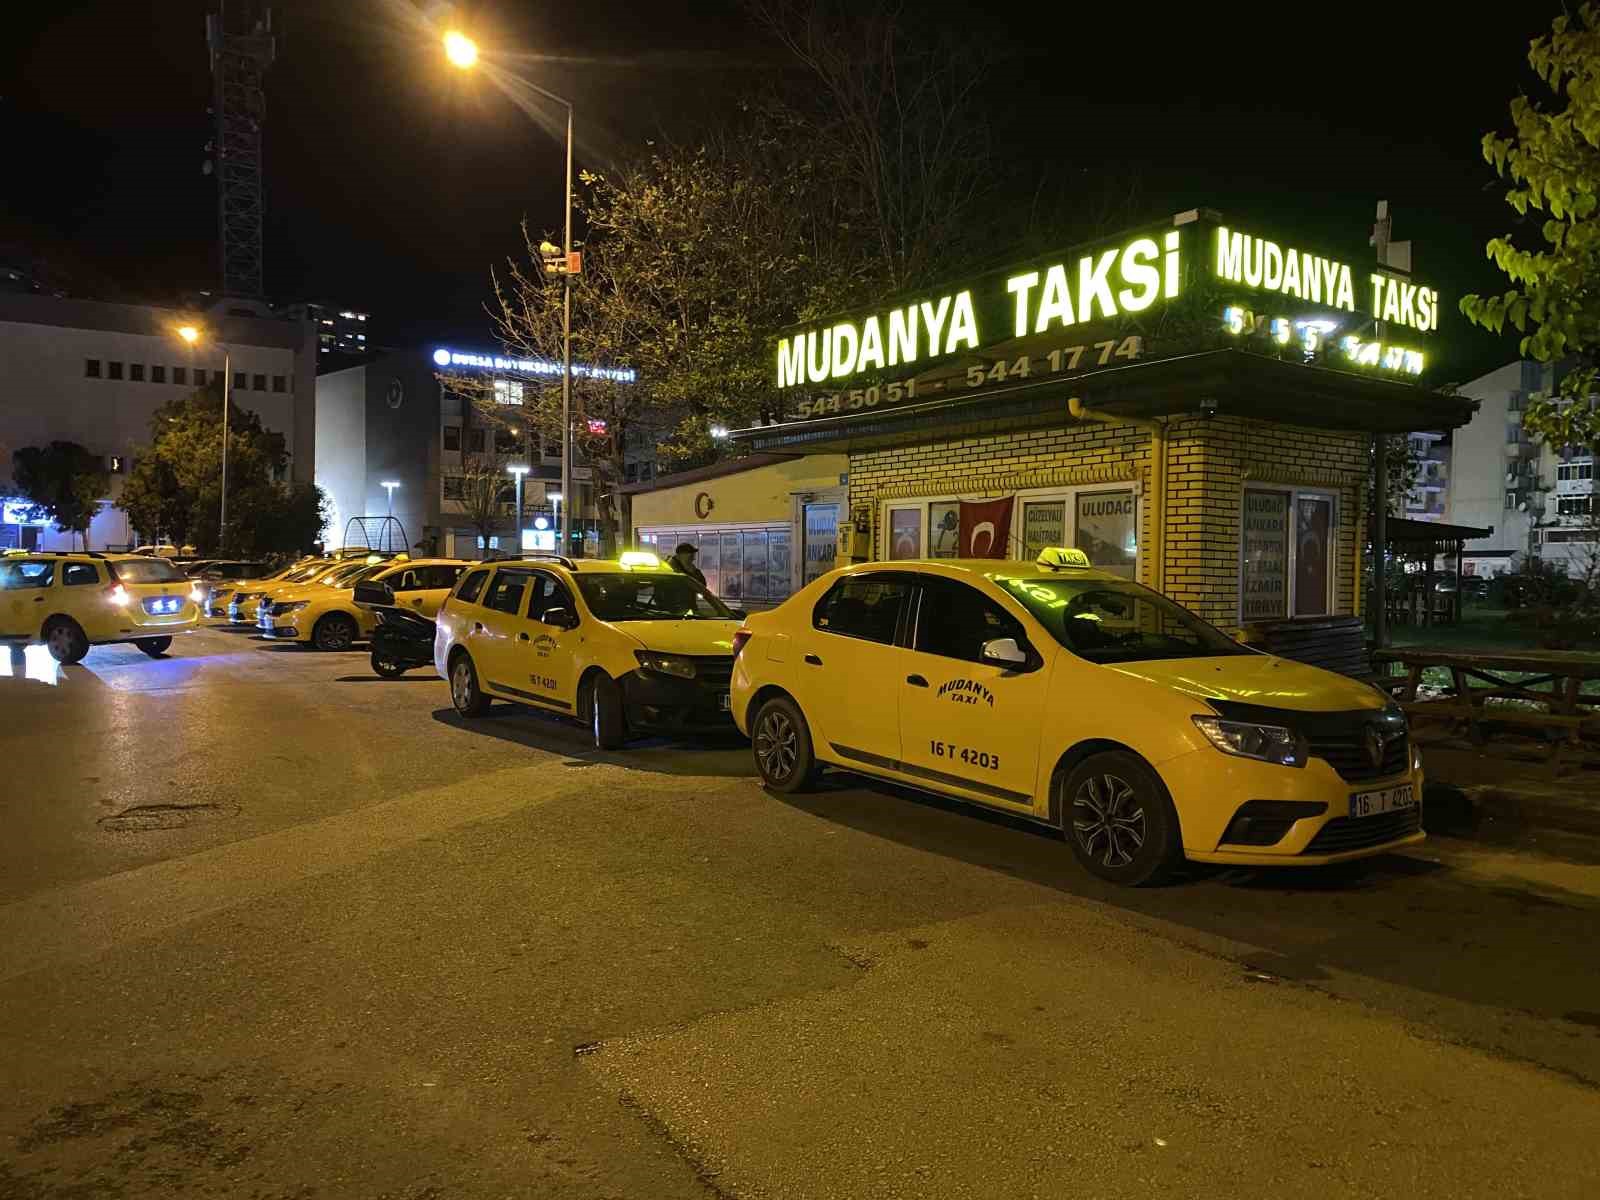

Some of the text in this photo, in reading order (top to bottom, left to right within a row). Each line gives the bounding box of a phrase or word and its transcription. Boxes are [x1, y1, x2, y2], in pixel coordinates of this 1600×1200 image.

[1216, 226, 1355, 312] MUDANYA
[776, 290, 980, 388] MUDANYA
[798, 392, 842, 419] 544
[850, 386, 879, 410] 50
[887, 378, 915, 402] 51
[966, 356, 1031, 387] 544
[1046, 346, 1085, 372] 17
[1094, 335, 1139, 365] 74
[937, 679, 995, 708] MUDANYA
[951, 693, 978, 705] TAXI
[930, 740, 999, 770] 16 T 4203
[1358, 795, 1369, 815] 16
[1380, 791, 1387, 811] T
